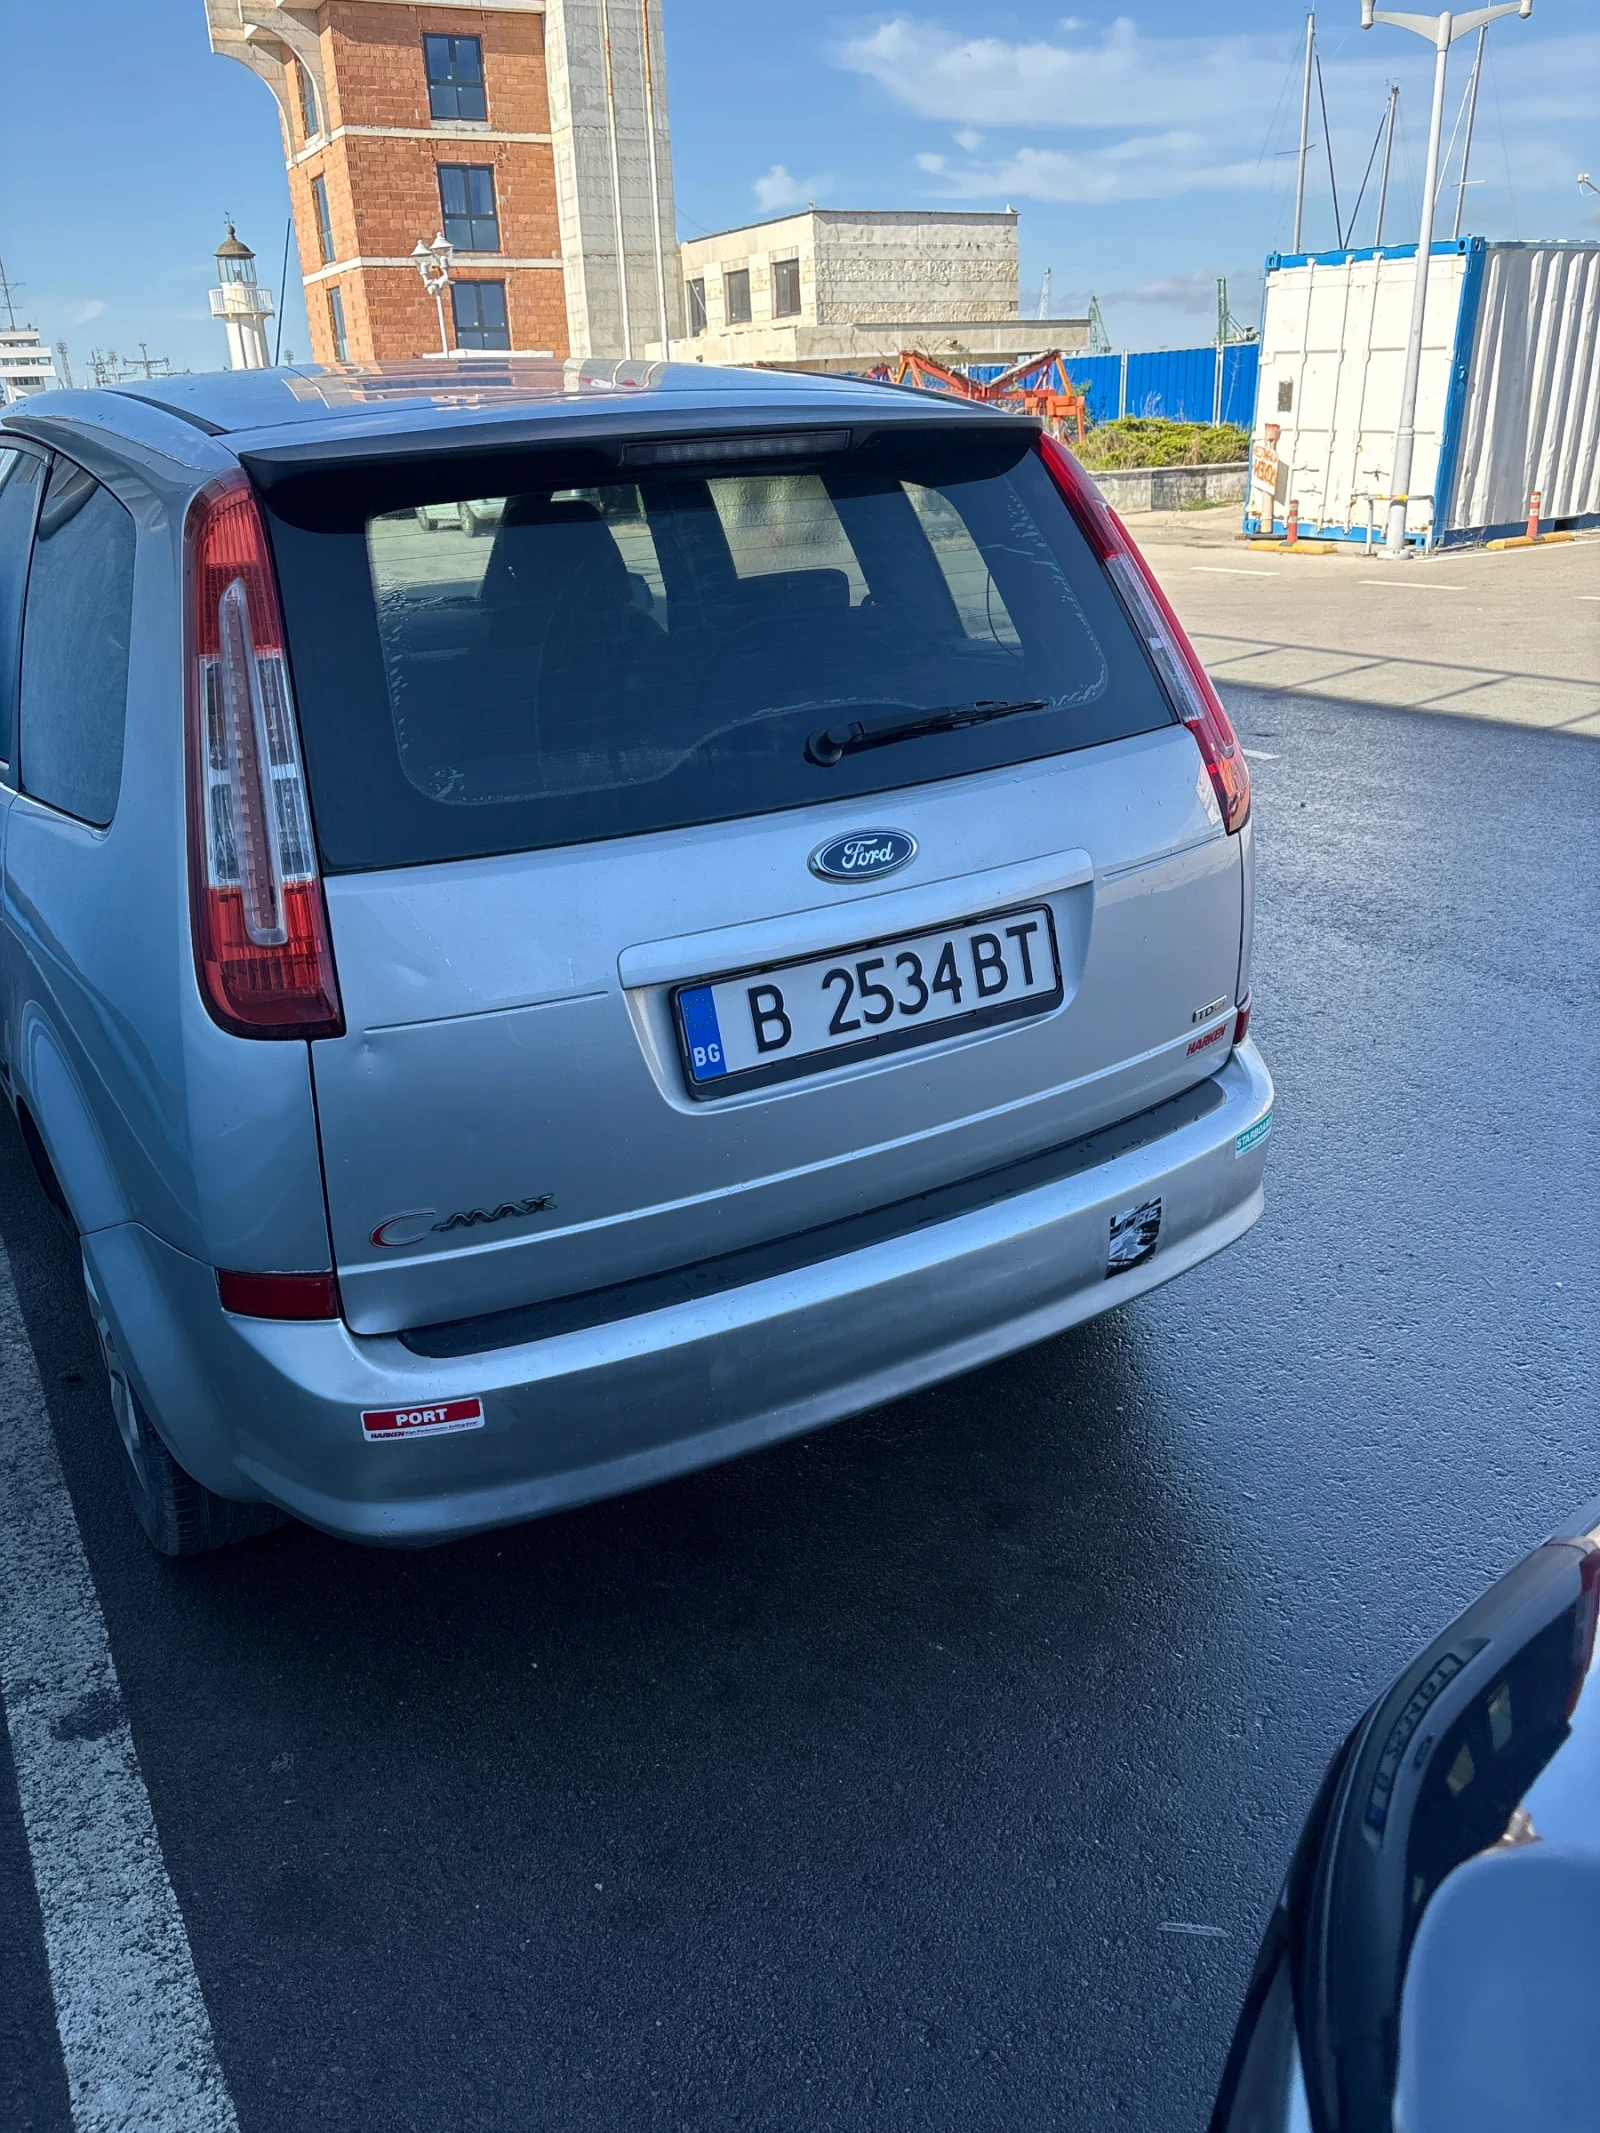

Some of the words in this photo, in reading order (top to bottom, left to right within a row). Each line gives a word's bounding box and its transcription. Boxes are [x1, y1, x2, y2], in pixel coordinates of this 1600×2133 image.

[841, 837, 893, 869] Ford
[747, 984, 792, 1054] B
[1186, 1023, 1228, 1056] HARKEN
[693, 1043, 721, 1068] BG
[396, 1408, 448, 1426] PORT
[371, 1431, 404, 1439] HARKEN
